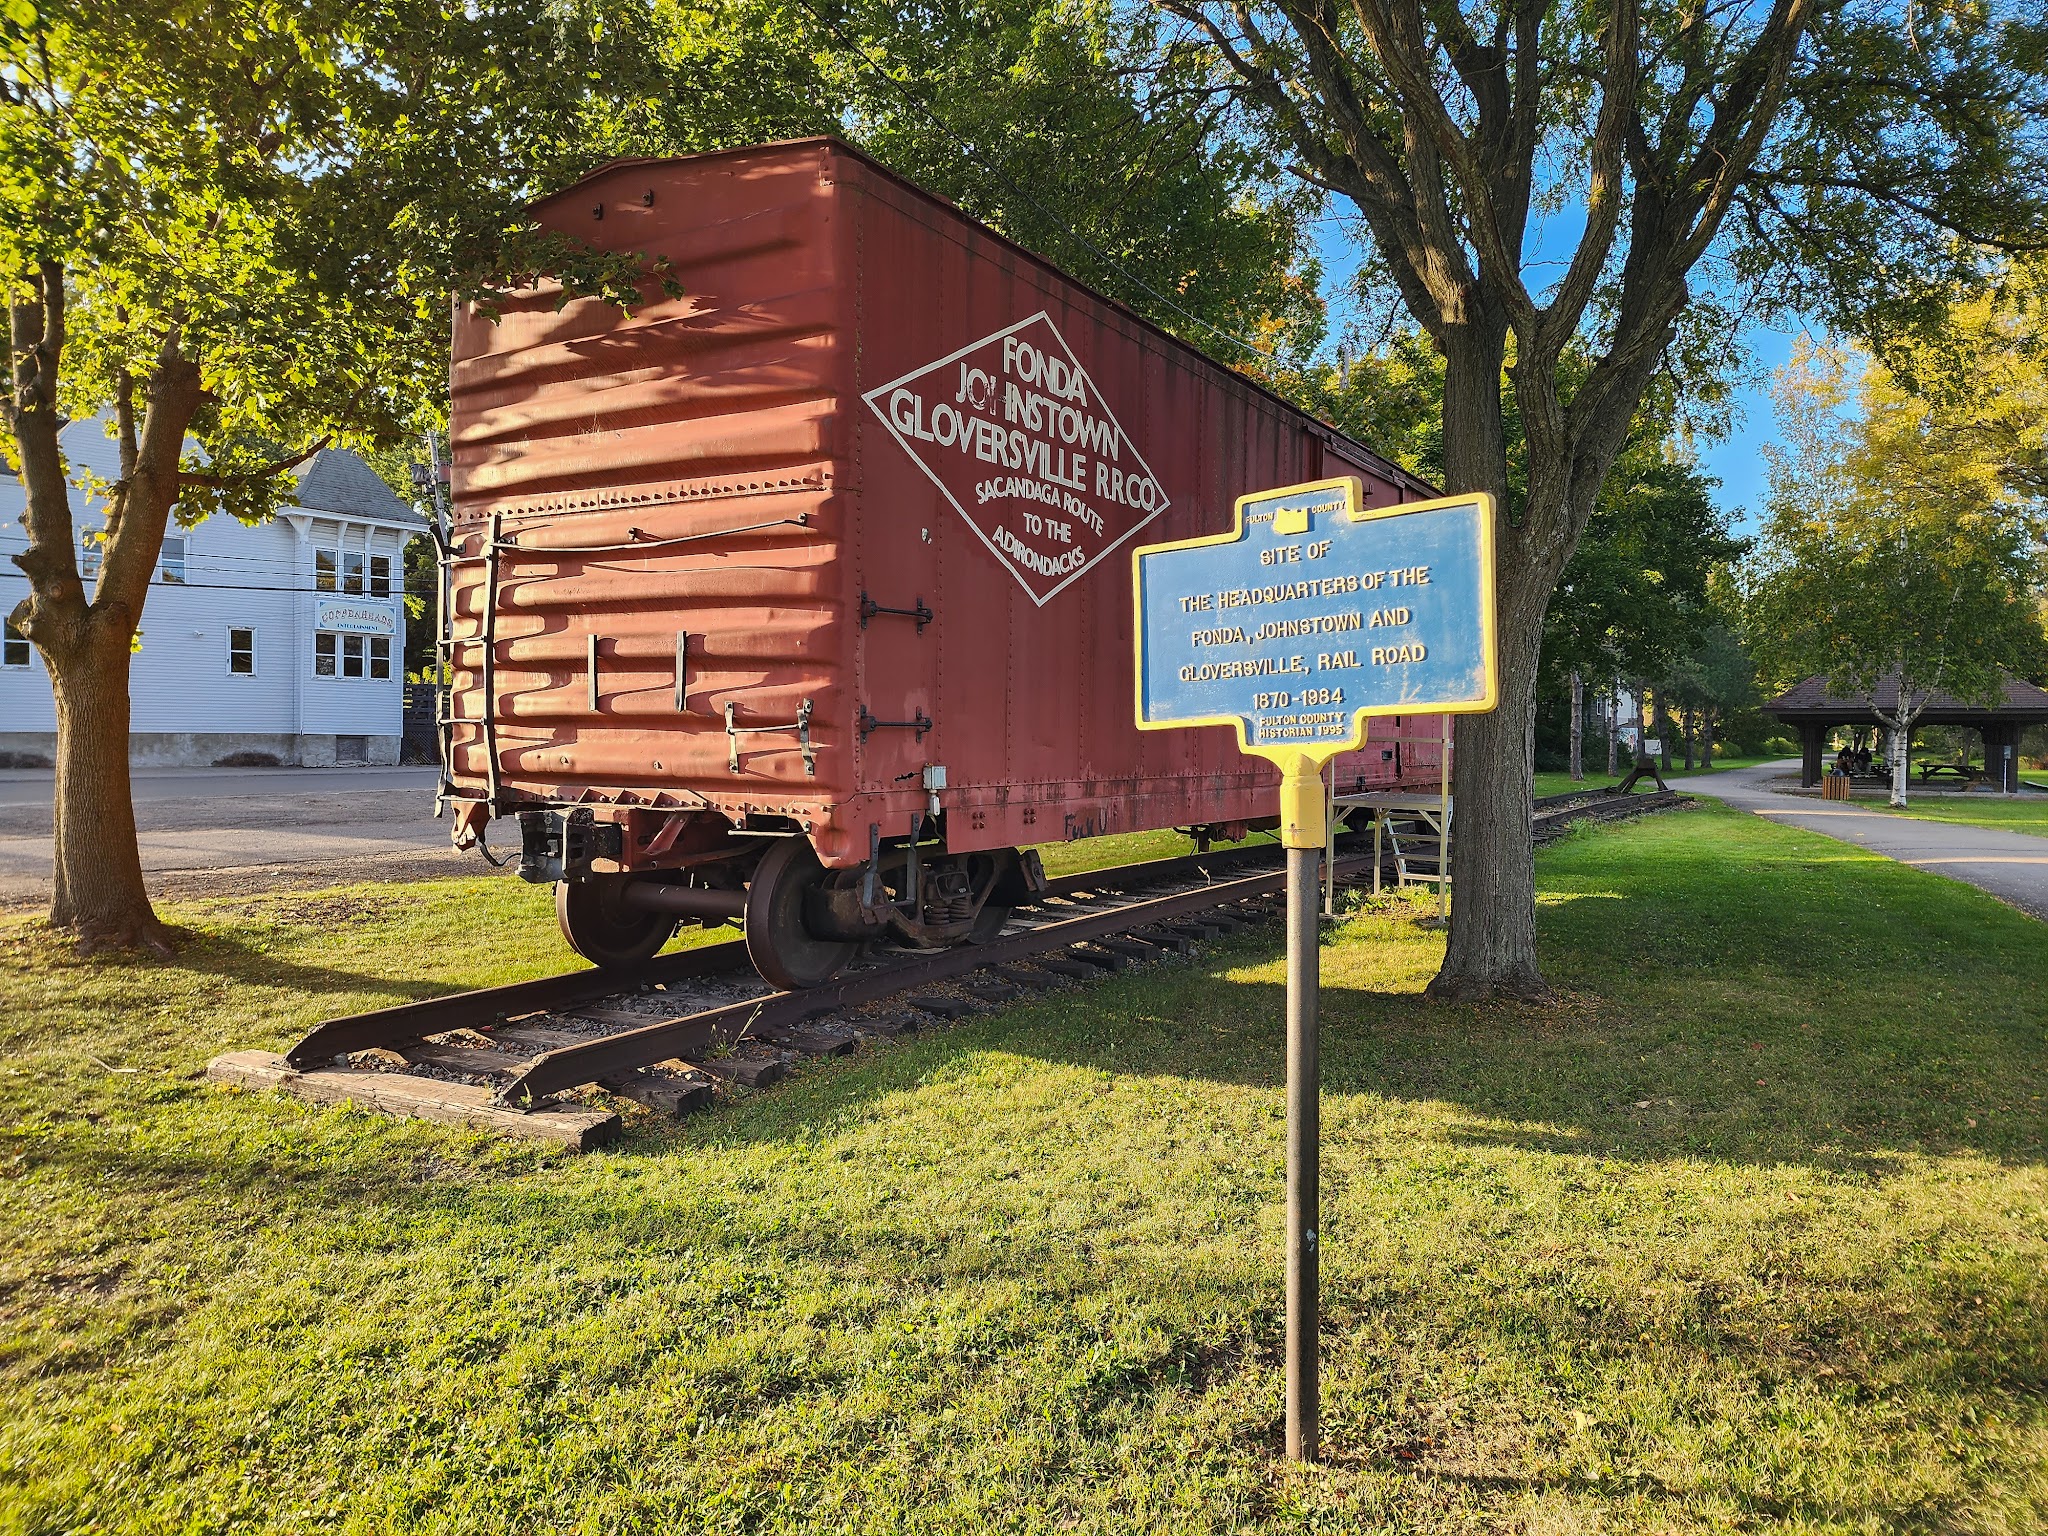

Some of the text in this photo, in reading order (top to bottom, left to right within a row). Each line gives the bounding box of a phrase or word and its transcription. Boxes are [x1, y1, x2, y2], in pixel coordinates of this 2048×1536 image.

[1004, 336, 1088, 407] FONDA
[956, 361, 1119, 461] JOHNSTOWN
[890, 388, 1087, 491] GLOVERSVILLE
[976, 477, 1104, 537] SACANDAGA ROUTE
[1246, 501, 1345, 524] FULTON COUNTY
[1023, 512, 1072, 543] TO THE
[992, 525, 1086, 577] ADIRONDACKS
[1260, 540, 1333, 566] SITE OF
[1179, 566, 1431, 613] THE HEADQUARTERS OF THE
[1192, 607, 1410, 647] FONDA, JOHNSTOWN AND
[1179, 644, 1428, 682] GLOVERSVILLE, RAIL ROAD
[1259, 724, 1345, 739] HISTORIAN 1995
[1260, 711, 1346, 727] FULTON COUNTY
